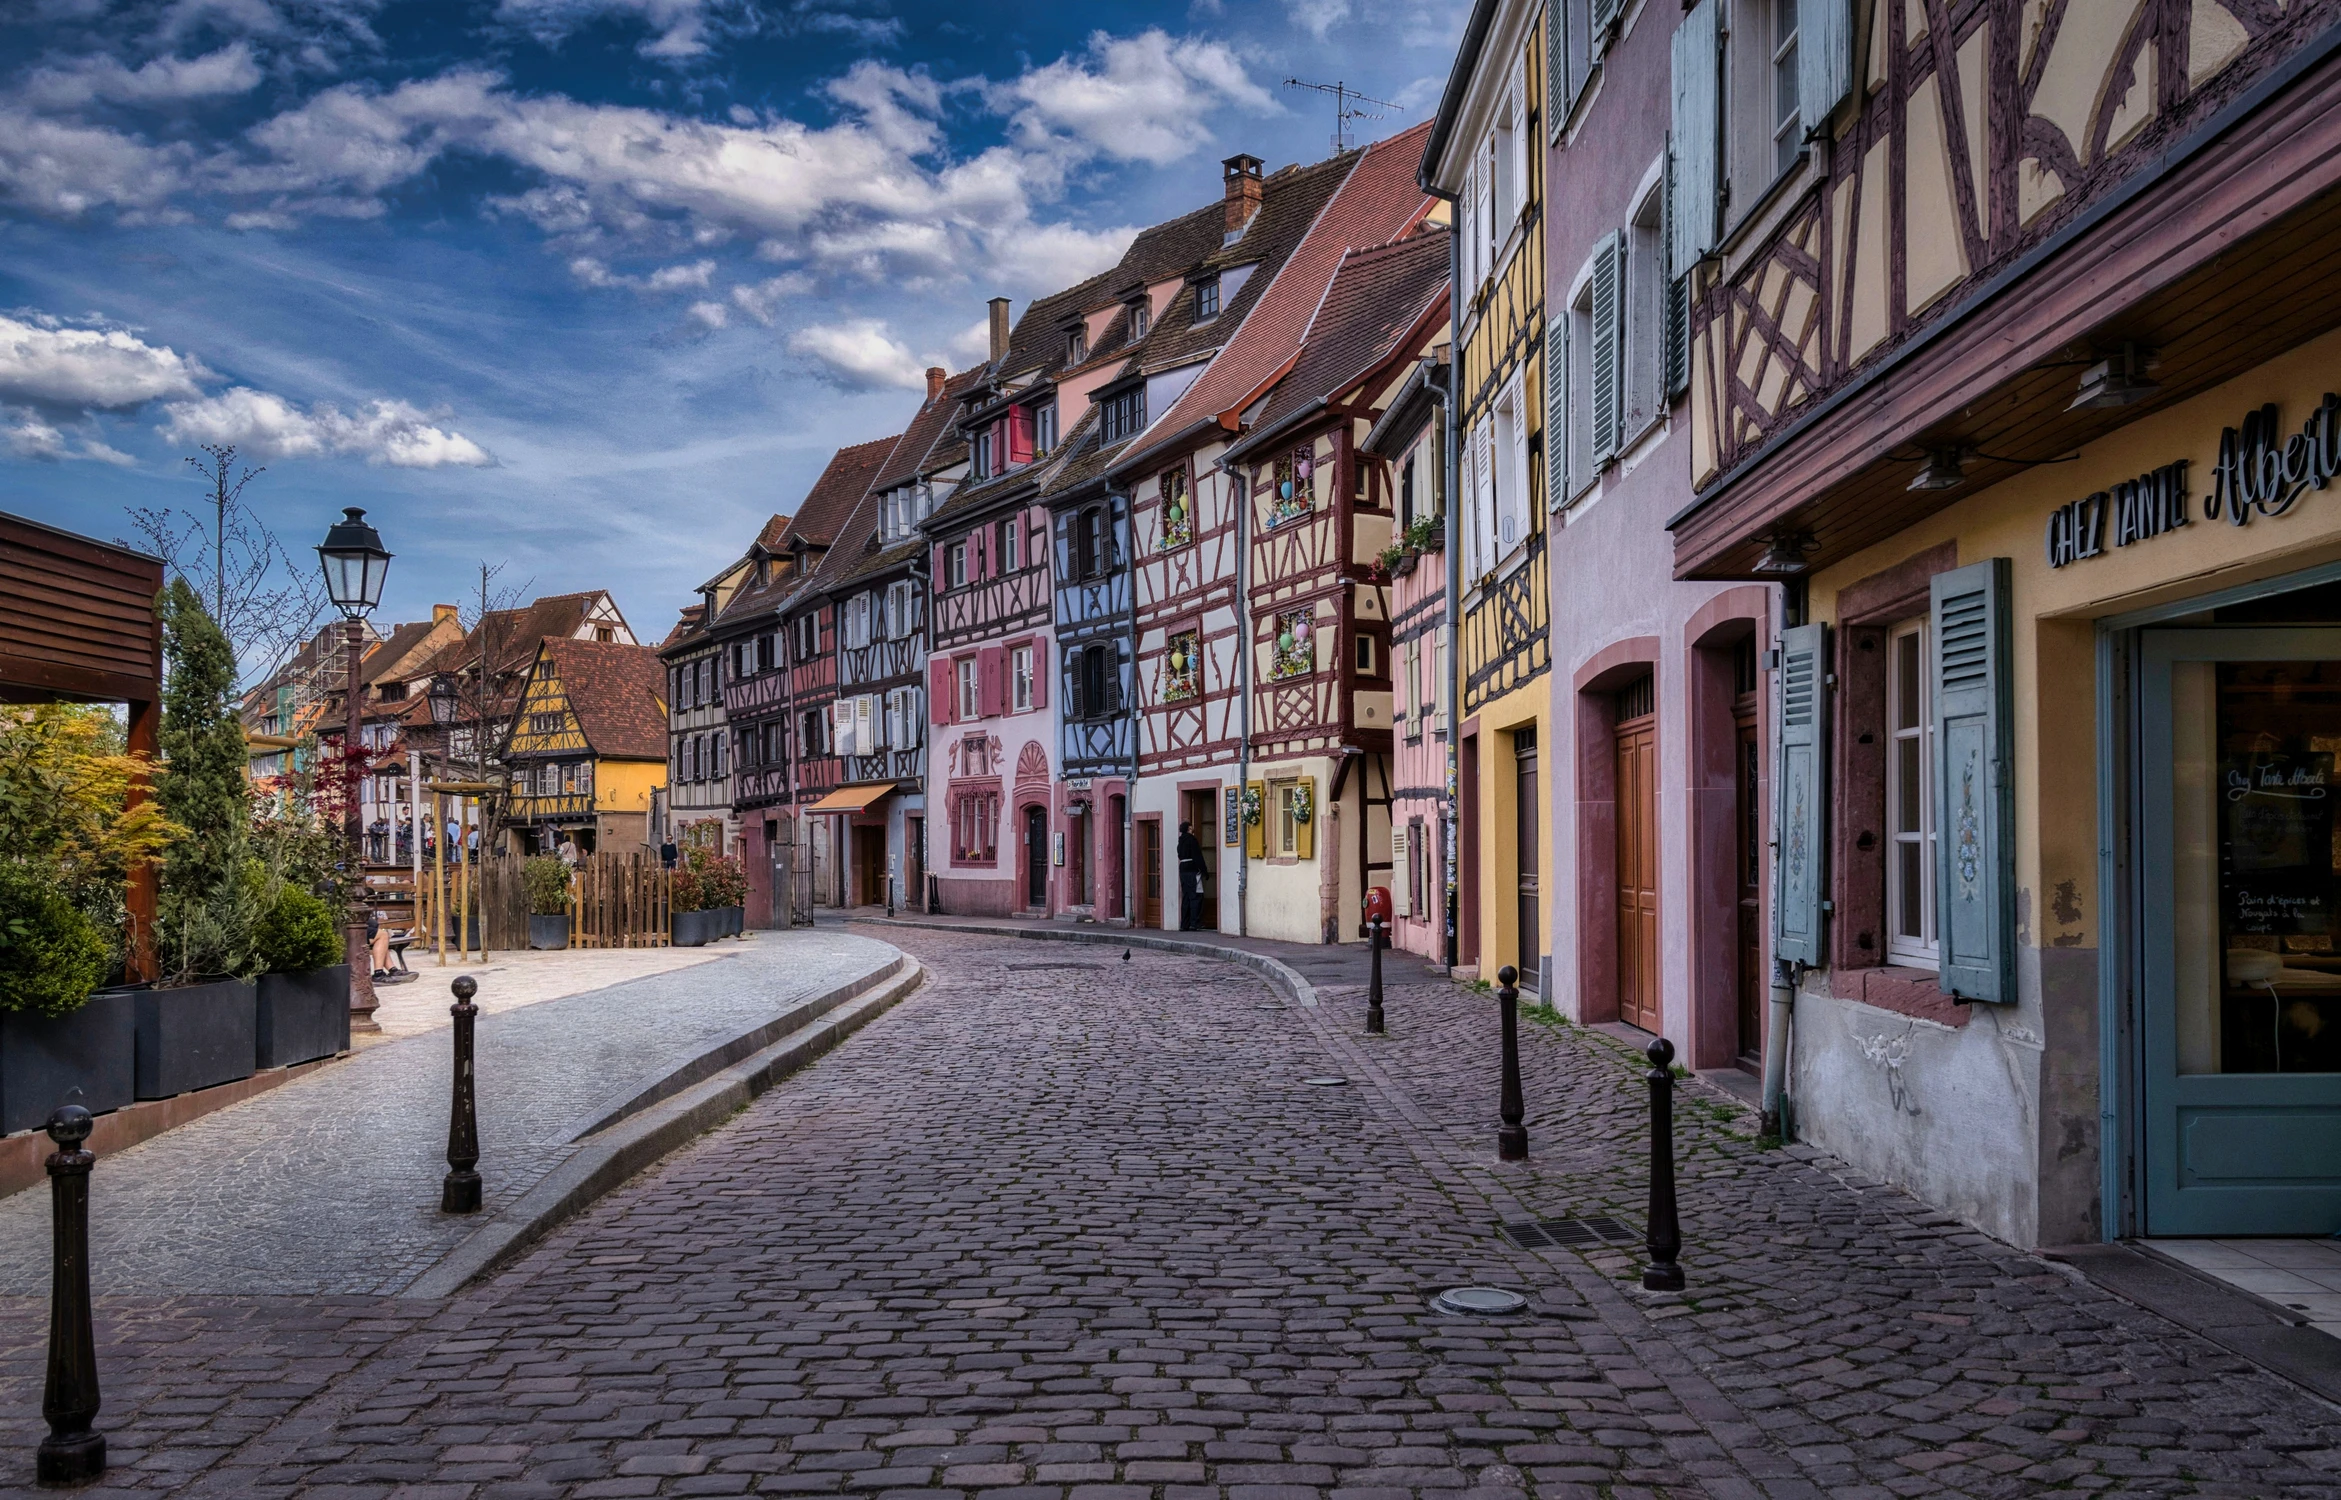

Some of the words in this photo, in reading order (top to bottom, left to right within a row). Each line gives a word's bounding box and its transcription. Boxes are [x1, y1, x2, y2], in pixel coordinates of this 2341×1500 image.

[2044, 491, 2110, 568] CHEZ
[2110, 458, 2190, 547] TANTE
[2203, 392, 2341, 527] Albert
[2228, 769, 2251, 794] Chez
[2256, 763, 2284, 787] Tante
[2287, 766, 2325, 786] Alberte
[2238, 891, 2263, 906] Pain
[2309, 896, 2320, 905] et
[2239, 907, 2279, 922] Nougats
[2281, 910, 2290, 918] à
[2292, 907, 2305, 918] la
